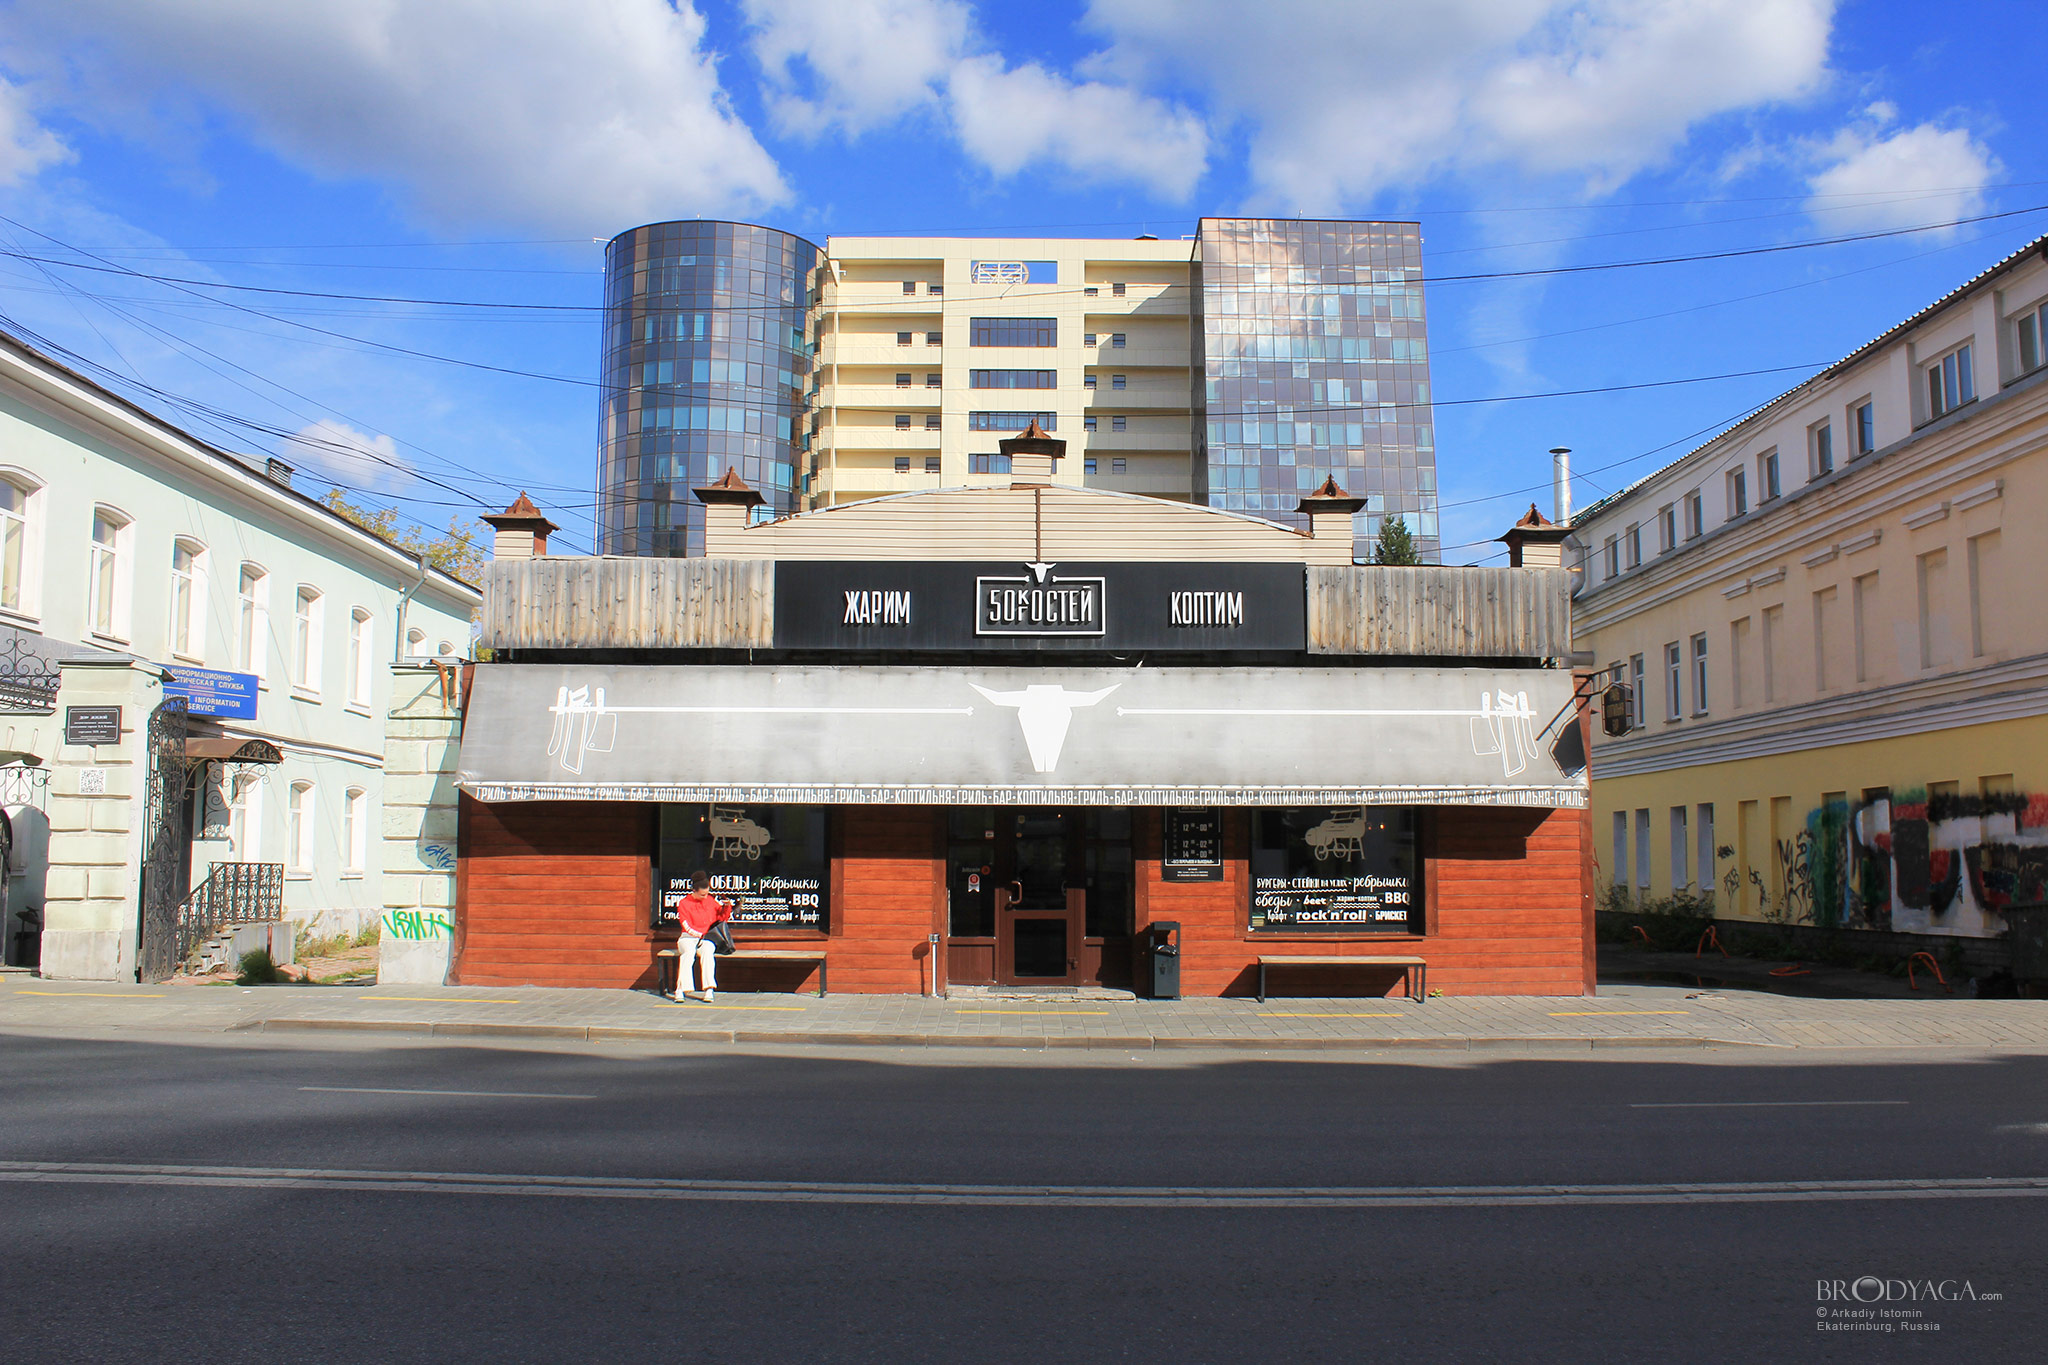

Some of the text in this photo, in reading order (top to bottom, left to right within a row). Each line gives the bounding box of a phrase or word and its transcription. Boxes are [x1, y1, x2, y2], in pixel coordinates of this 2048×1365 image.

[844, 591, 910, 623] ЖАРИМ
[1172, 592, 1242, 624] КОПТИМ
[218, 681, 245, 690] СЛУЖБА
[187, 702, 216, 712] SERVICE
[194, 696, 241, 708] INFORMATION
[476, 787, 1584, 806] ГРИЛЬ БАР КОПТИЛЬНЯ ГРИЛЬ БАР КОПТИЛЬНЯ ГРИЛЬ БАР КОПТИЛЬНЯ ГРИЛЬ БАР КОПТИЛЬНЯ ГРИЛЬ БАР КОПТИЛЬНЯ ГРИЛЬ БАР КОПТИЛЬНЯ ГРИЛЬ БАР КОПТИЛЬНЯ ГРИЛЬ БАР КОПТИЛЬНЯ ГРИЛЬ БАР КОПТИЛЬНЯ ГРИЛЬ
[670, 875, 819, 894] БУРГЕ ОБЕДЫ ребрышки
[1257, 878, 1287, 888] БУРГЕРЫ
[792, 893, 819, 908] BBQ
[1255, 892, 1293, 913] обеды
[1384, 892, 1410, 906] BBQ
[1375, 911, 1408, 921] БРИСКЕТ
